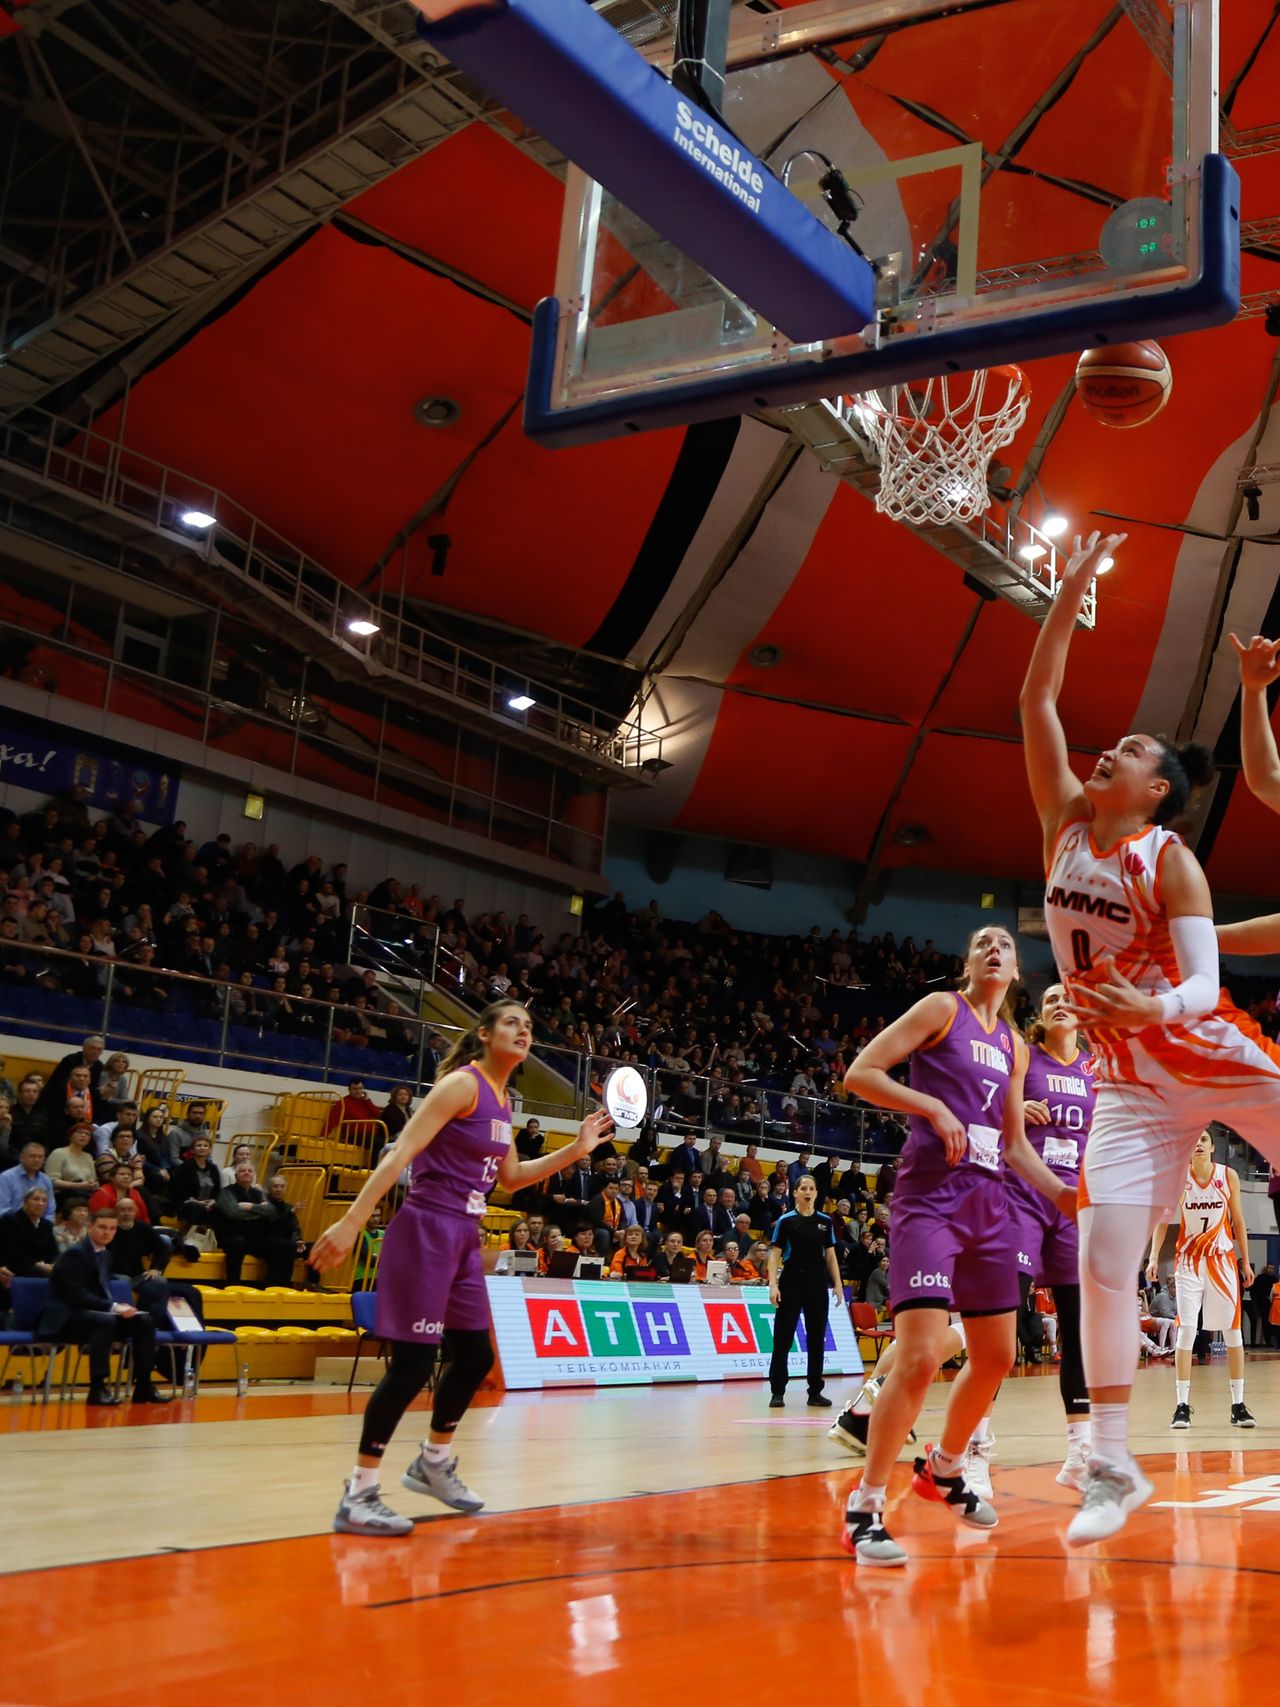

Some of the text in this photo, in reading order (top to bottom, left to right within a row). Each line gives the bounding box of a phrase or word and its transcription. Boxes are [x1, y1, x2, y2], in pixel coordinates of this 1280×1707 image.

[676, 101, 764, 194] Schelde
[674, 126, 760, 213] International
[1072, 929, 1093, 971] 0
[982, 1079, 999, 1111] 7
[1051, 1104, 1083, 1130] 10
[1185, 1201, 1223, 1210] UMMC
[1200, 1217, 1209, 1233] 7
[1017, 1251, 1032, 1266] ts.
[412, 1318, 444, 1334] dot
[556, 1361, 681, 1373] ТЕЛЕКОМПАНИЯ
